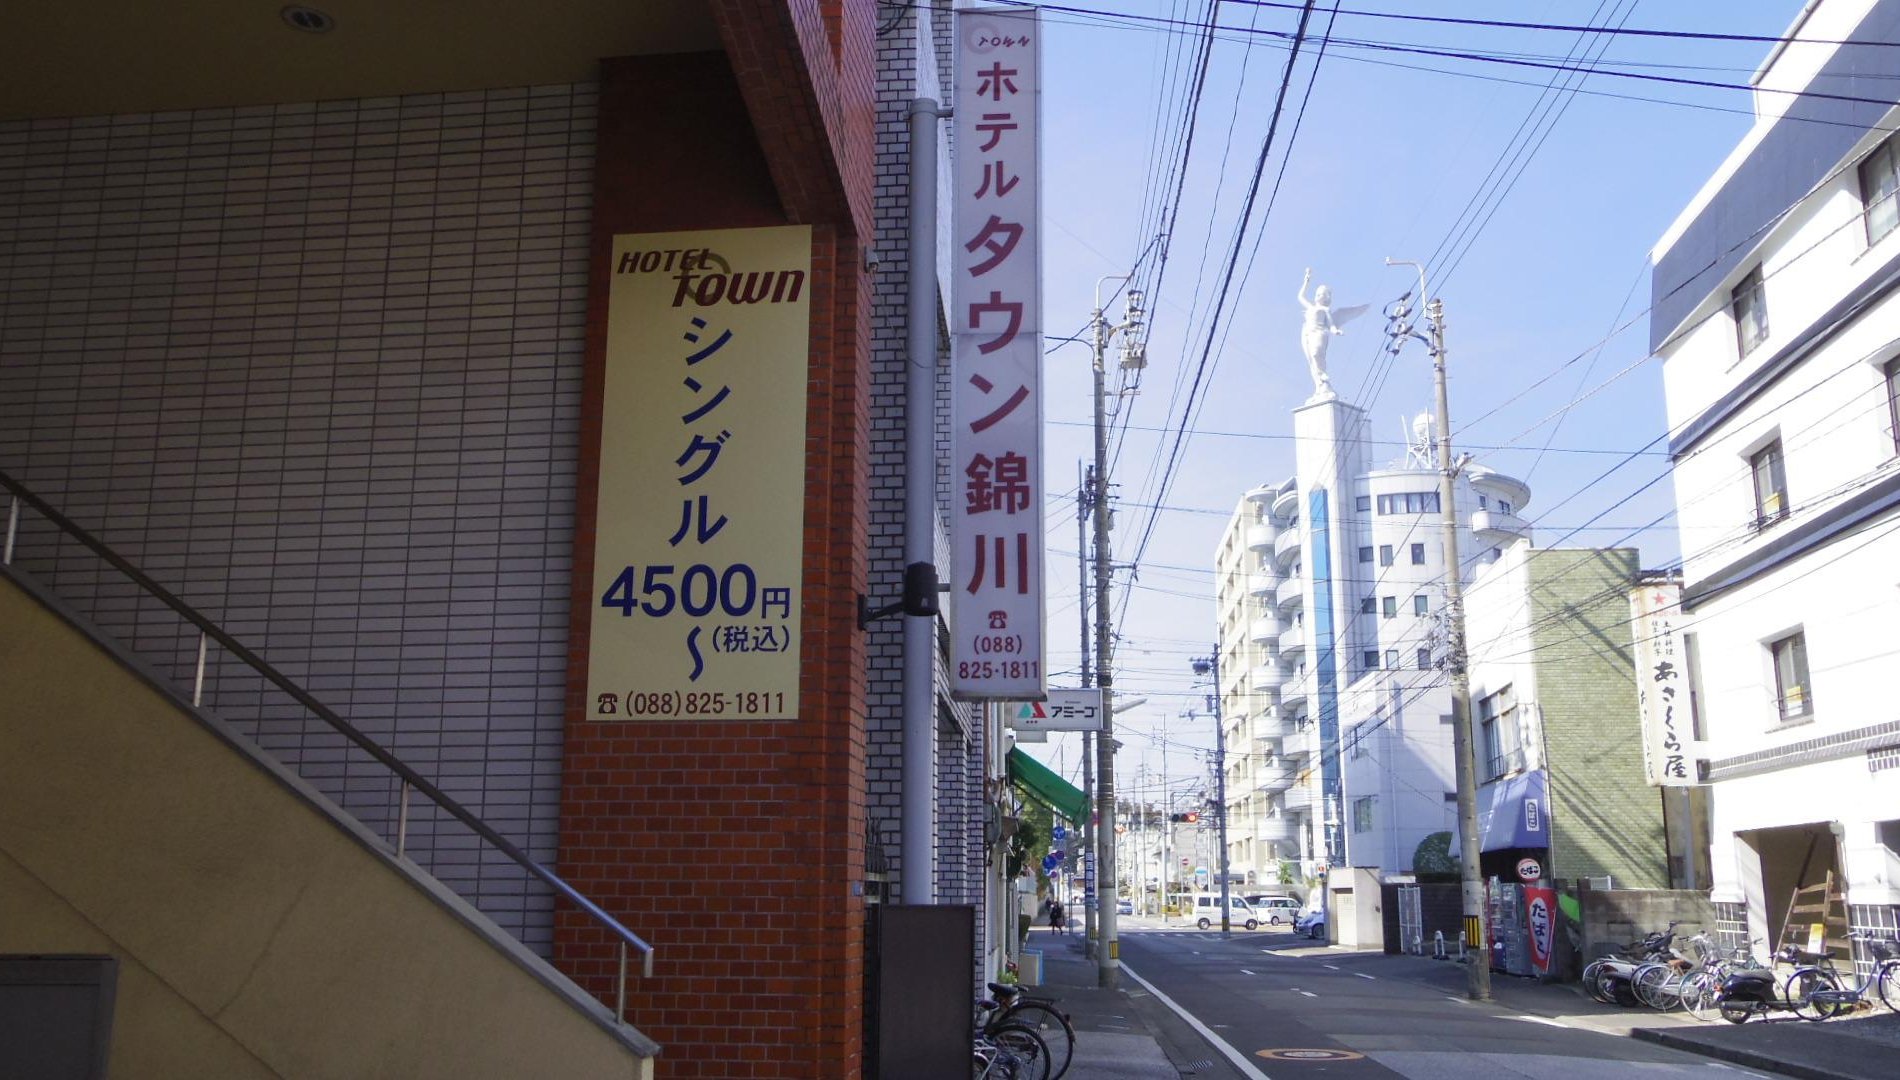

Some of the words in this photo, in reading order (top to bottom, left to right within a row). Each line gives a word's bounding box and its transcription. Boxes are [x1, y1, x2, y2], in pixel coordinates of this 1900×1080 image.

[978, 35, 1031, 48] TOWN
[617, 248, 713, 274] HOTEL
[668, 316, 733, 547] シングル
[712, 624, 790, 653] (税込)
[973, 635, 1023, 654] (088)
[626, 690, 784, 717] (088)825-1811
[1050, 706, 1098, 718] アミーゴ
[1653, 660, 1688, 779] あさくら屋
